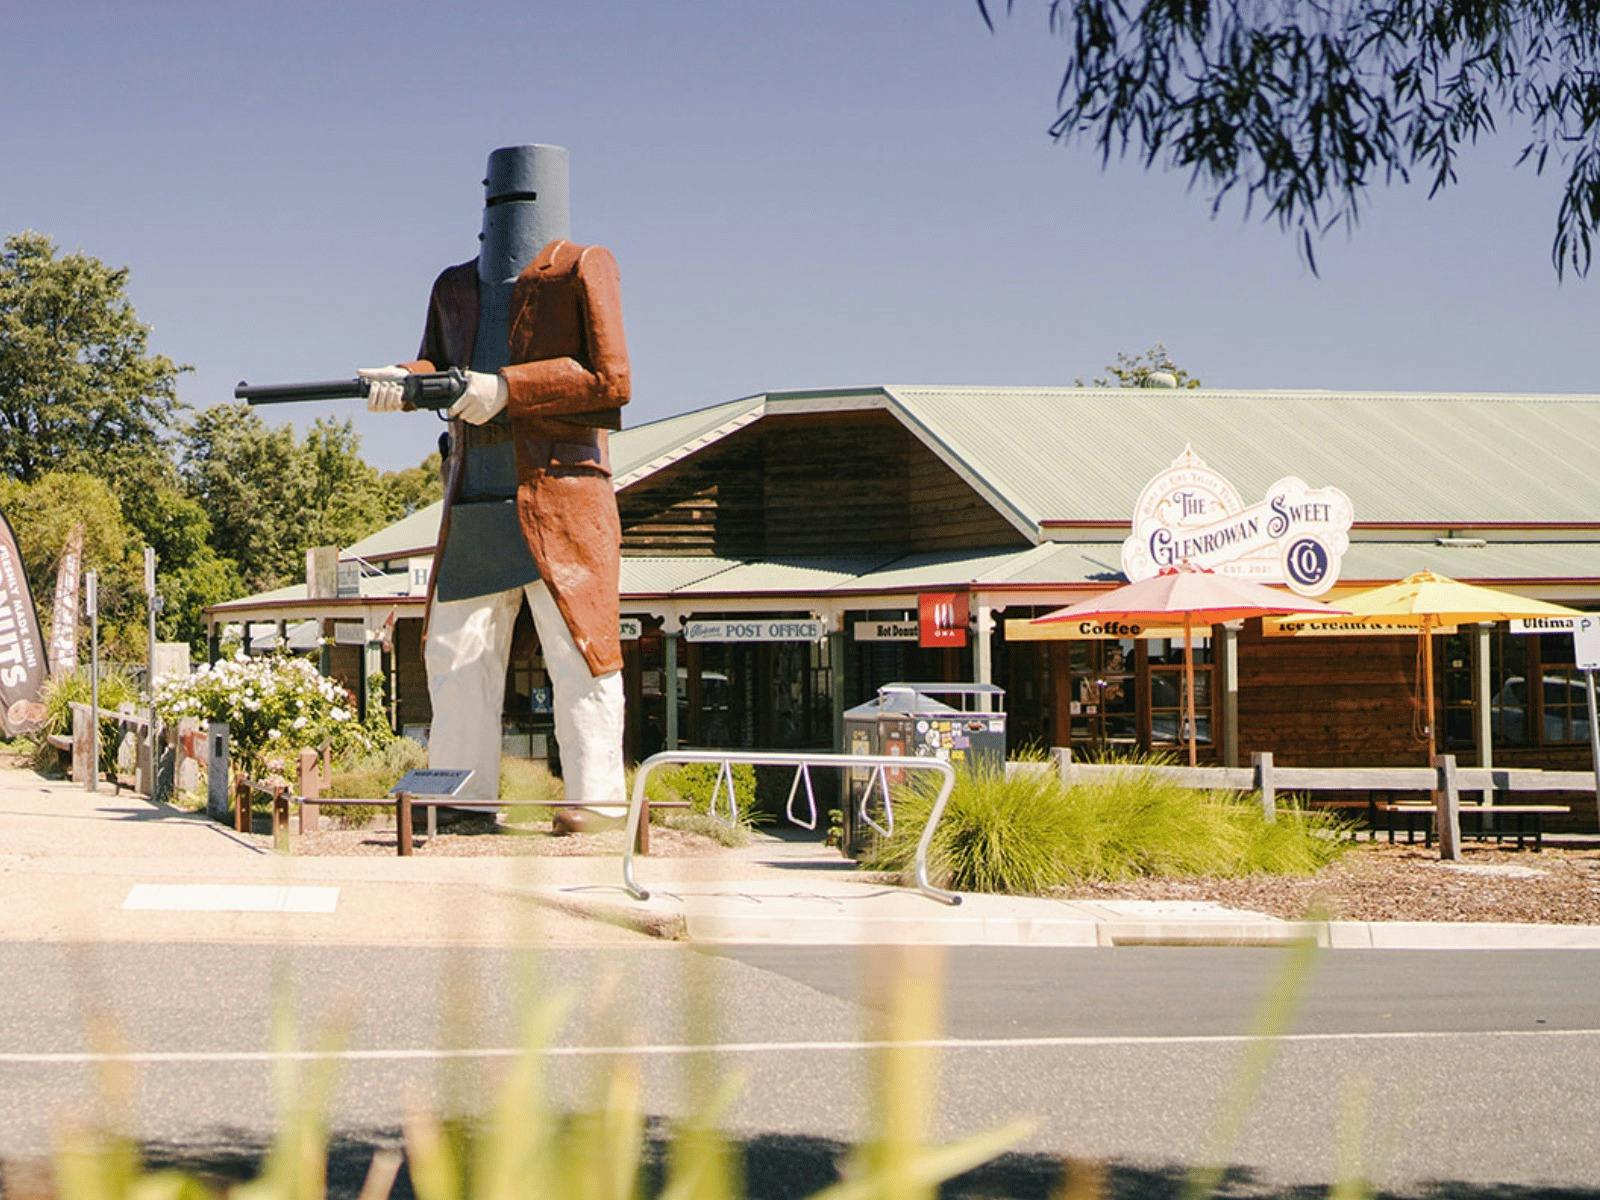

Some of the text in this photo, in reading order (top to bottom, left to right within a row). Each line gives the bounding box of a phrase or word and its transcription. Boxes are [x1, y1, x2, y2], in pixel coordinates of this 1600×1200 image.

[1172, 491, 1206, 518] THE
[1149, 517, 1260, 567] GLENROWAN
[1266, 494, 1333, 539] SWEET
[13, 600, 29, 635] MADE
[23, 639, 37, 668] MINI
[726, 624, 762, 637] POST
[768, 623, 817, 637] OFFICE
[877, 624, 919, 637] Hot Donut
[1079, 621, 1141, 635] Coffee
